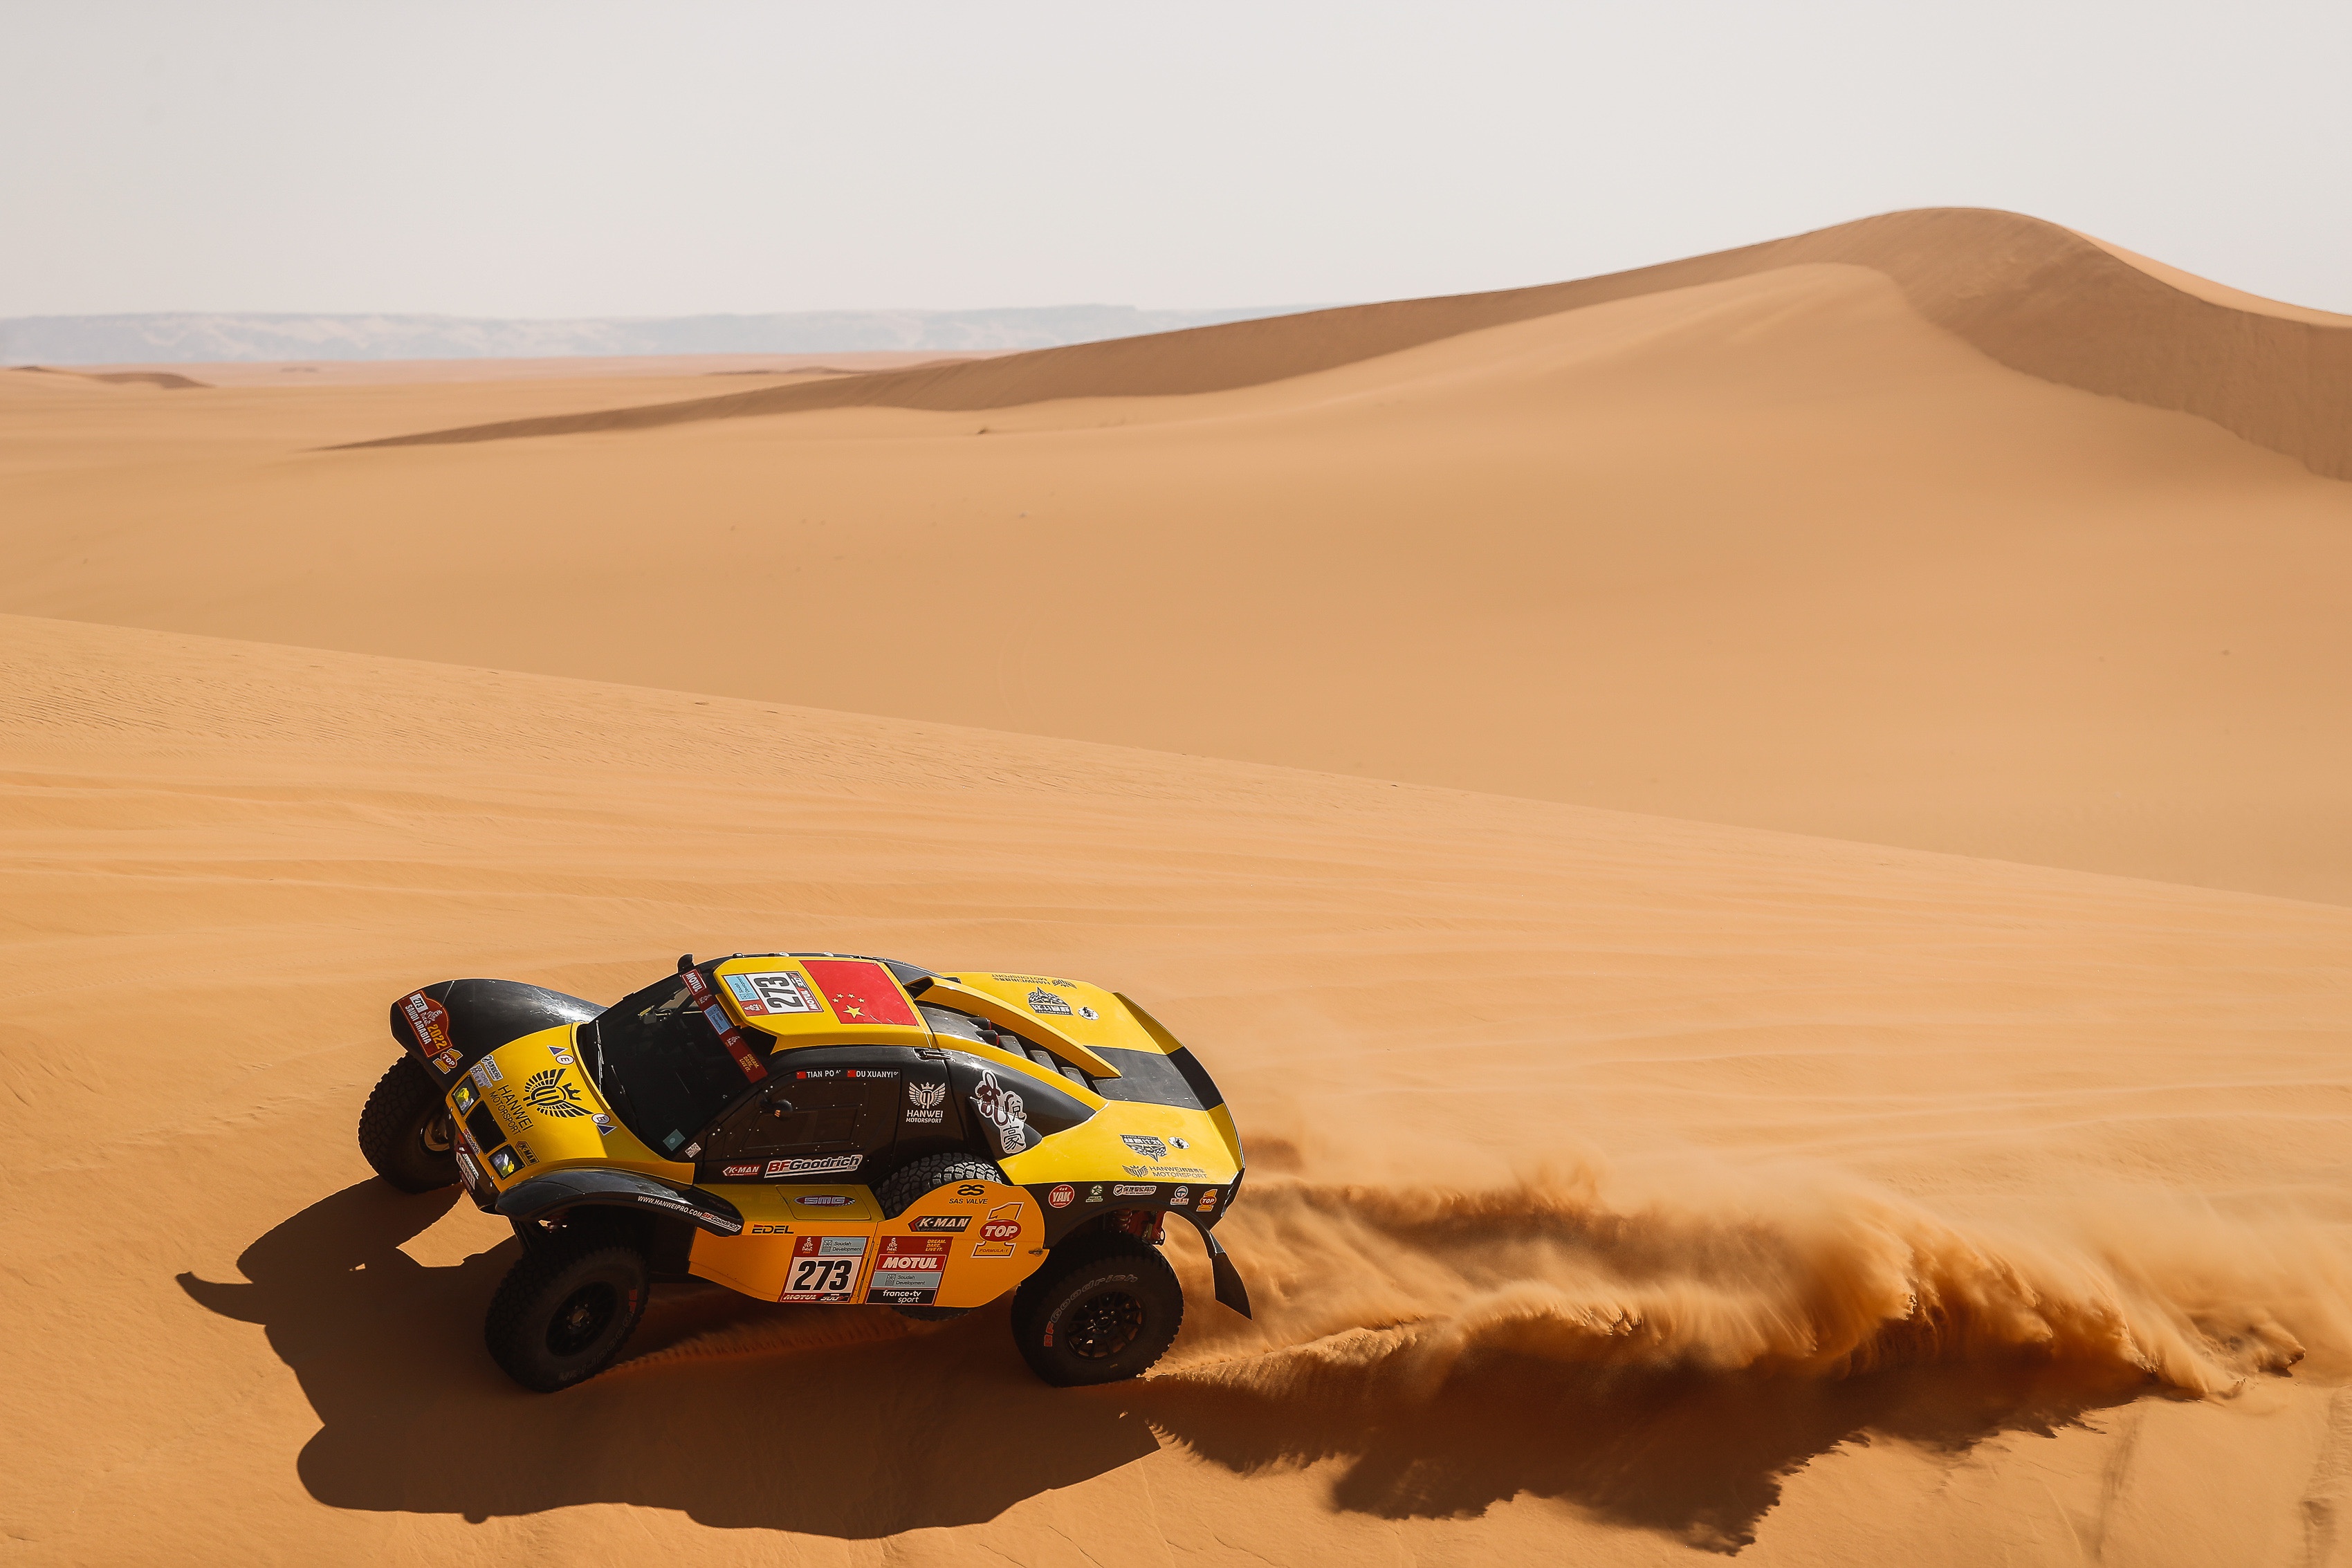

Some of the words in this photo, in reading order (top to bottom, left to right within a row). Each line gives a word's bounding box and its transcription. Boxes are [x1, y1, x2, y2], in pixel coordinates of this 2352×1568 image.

[686, 972, 703, 993] MOTUL
[753, 977, 804, 1008] 273
[413, 997, 425, 1008] 273
[800, 990, 819, 1010] MOTUL
[405, 1004, 419, 1022] SAUDI
[414, 1020, 432, 1044] ARABIA
[420, 1012, 430, 1026] DAKAR
[428, 1024, 447, 1049] 2022
[443, 1053, 455, 1066] TOP
[489, 1090, 521, 1136] MOTORSPORT
[498, 1084, 535, 1132] HANWEI
[906, 1109, 944, 1118] HANWEI
[520, 1143, 538, 1164] K-MAN
[767, 1154, 861, 1173] BFGoodrich
[637, 1195, 703, 1218] WWW.HANWEIPRO.COM
[1053, 1192, 1072, 1202] YAK
[751, 1224, 794, 1235] EDEL
[919, 1217, 969, 1228] K-MAN
[984, 1226, 1018, 1237] TOP
[882, 1257, 937, 1269] MOTUL
[792, 1260, 853, 1291] 273
[1044, 1274, 1138, 1347] BFGoodrich
